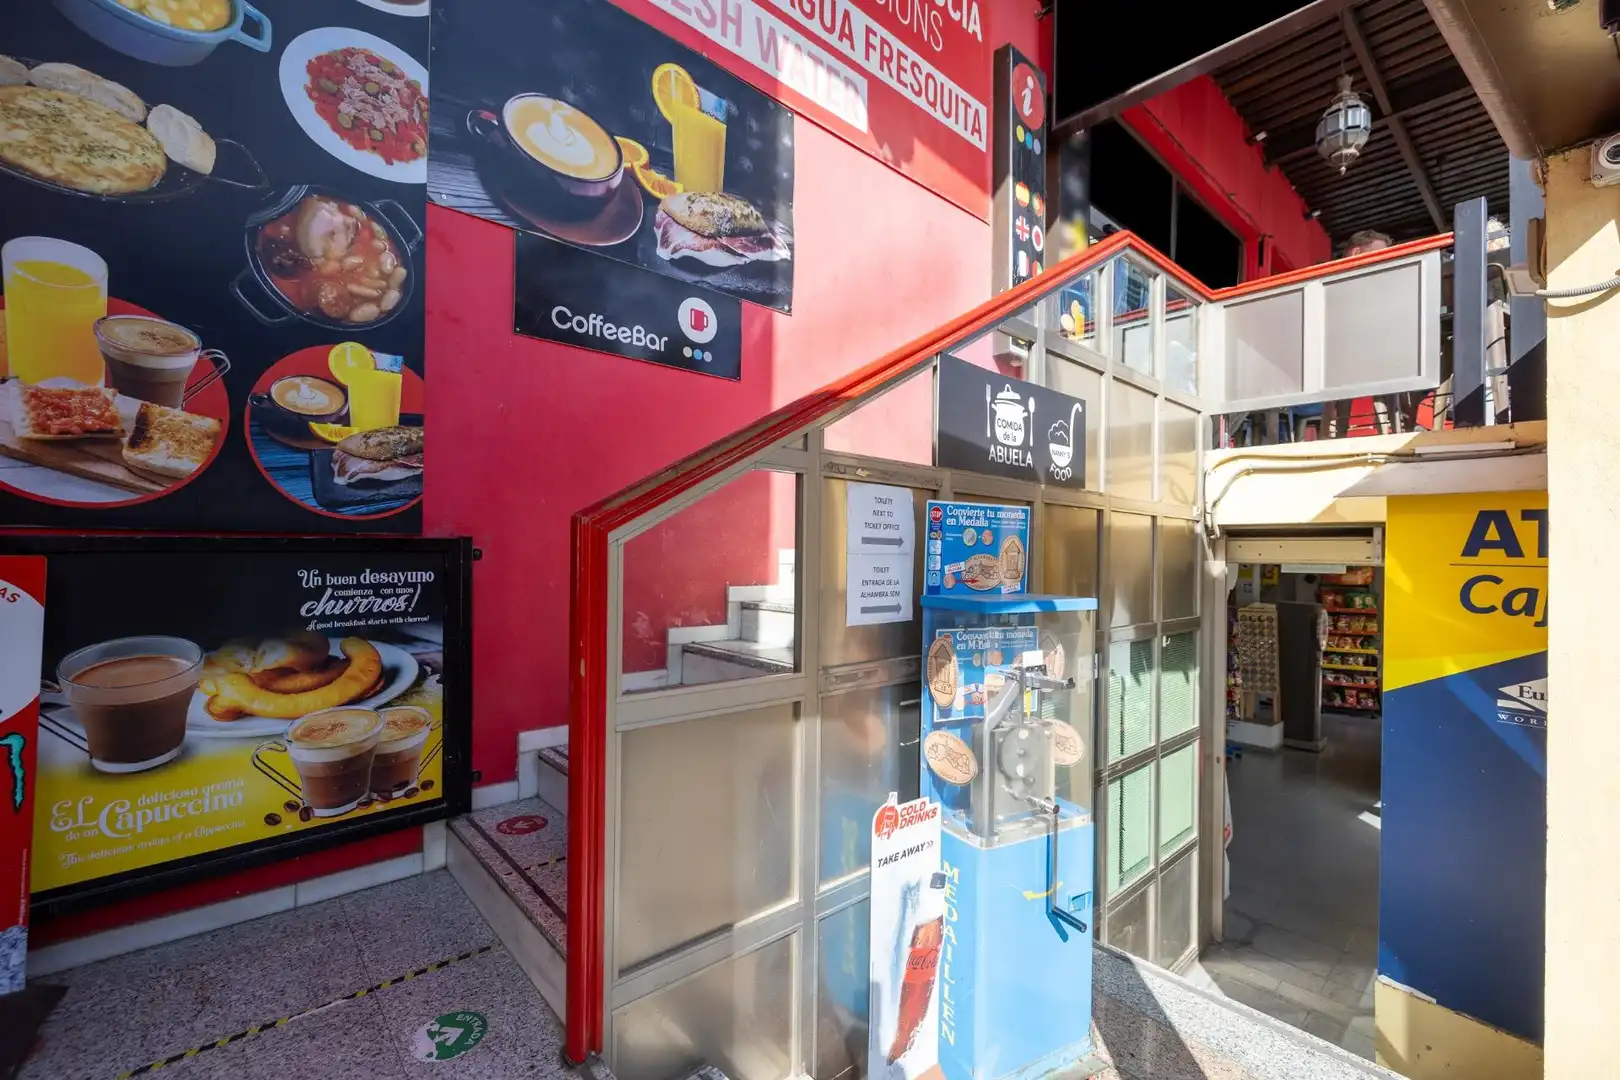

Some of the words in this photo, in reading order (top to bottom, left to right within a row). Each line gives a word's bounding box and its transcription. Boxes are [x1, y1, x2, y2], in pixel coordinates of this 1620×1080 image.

[936, 0, 983, 43] CIA
[785, 0, 855, 52] GUA
[864, 24, 982, 142] FRESQUITA
[551, 305, 669, 352] CoffeeBar
[997, 418, 1023, 432] COMIDA
[1002, 432, 1011, 441] de
[1011, 434, 1017, 443] la
[988, 444, 1034, 468] ABUELA
[1049, 463, 1072, 481] FOOD
[946, 505, 985, 518] Convierte
[987, 509, 995, 518] tu
[997, 510, 1026, 520] moneda
[946, 518, 957, 526] en
[958, 516, 989, 527] Medalla
[864, 522, 882, 530] TICKET
[883, 523, 900, 531] OFFICE
[297, 569, 322, 588] Un
[326, 573, 357, 586] buen
[360, 569, 435, 586] desayuno
[861, 579, 885, 587] ENTRADA
[380, 587, 394, 595] con
[396, 586, 414, 594] unos
[860, 591, 888, 599] ALHAMBRA
[300, 583, 421, 617] churros!
[316, 621, 333, 630] good
[334, 618, 366, 628] breakfast
[368, 617, 388, 625] starts
[389, 616, 404, 624] with
[100, 791, 243, 839] Capuccino
[899, 807, 938, 830] DRINKS
[900, 801, 927, 818] COLD
[877, 852, 900, 868] TAKE
[901, 842, 926, 859] AWAY
[455, 1013, 483, 1046] ENTRADA
